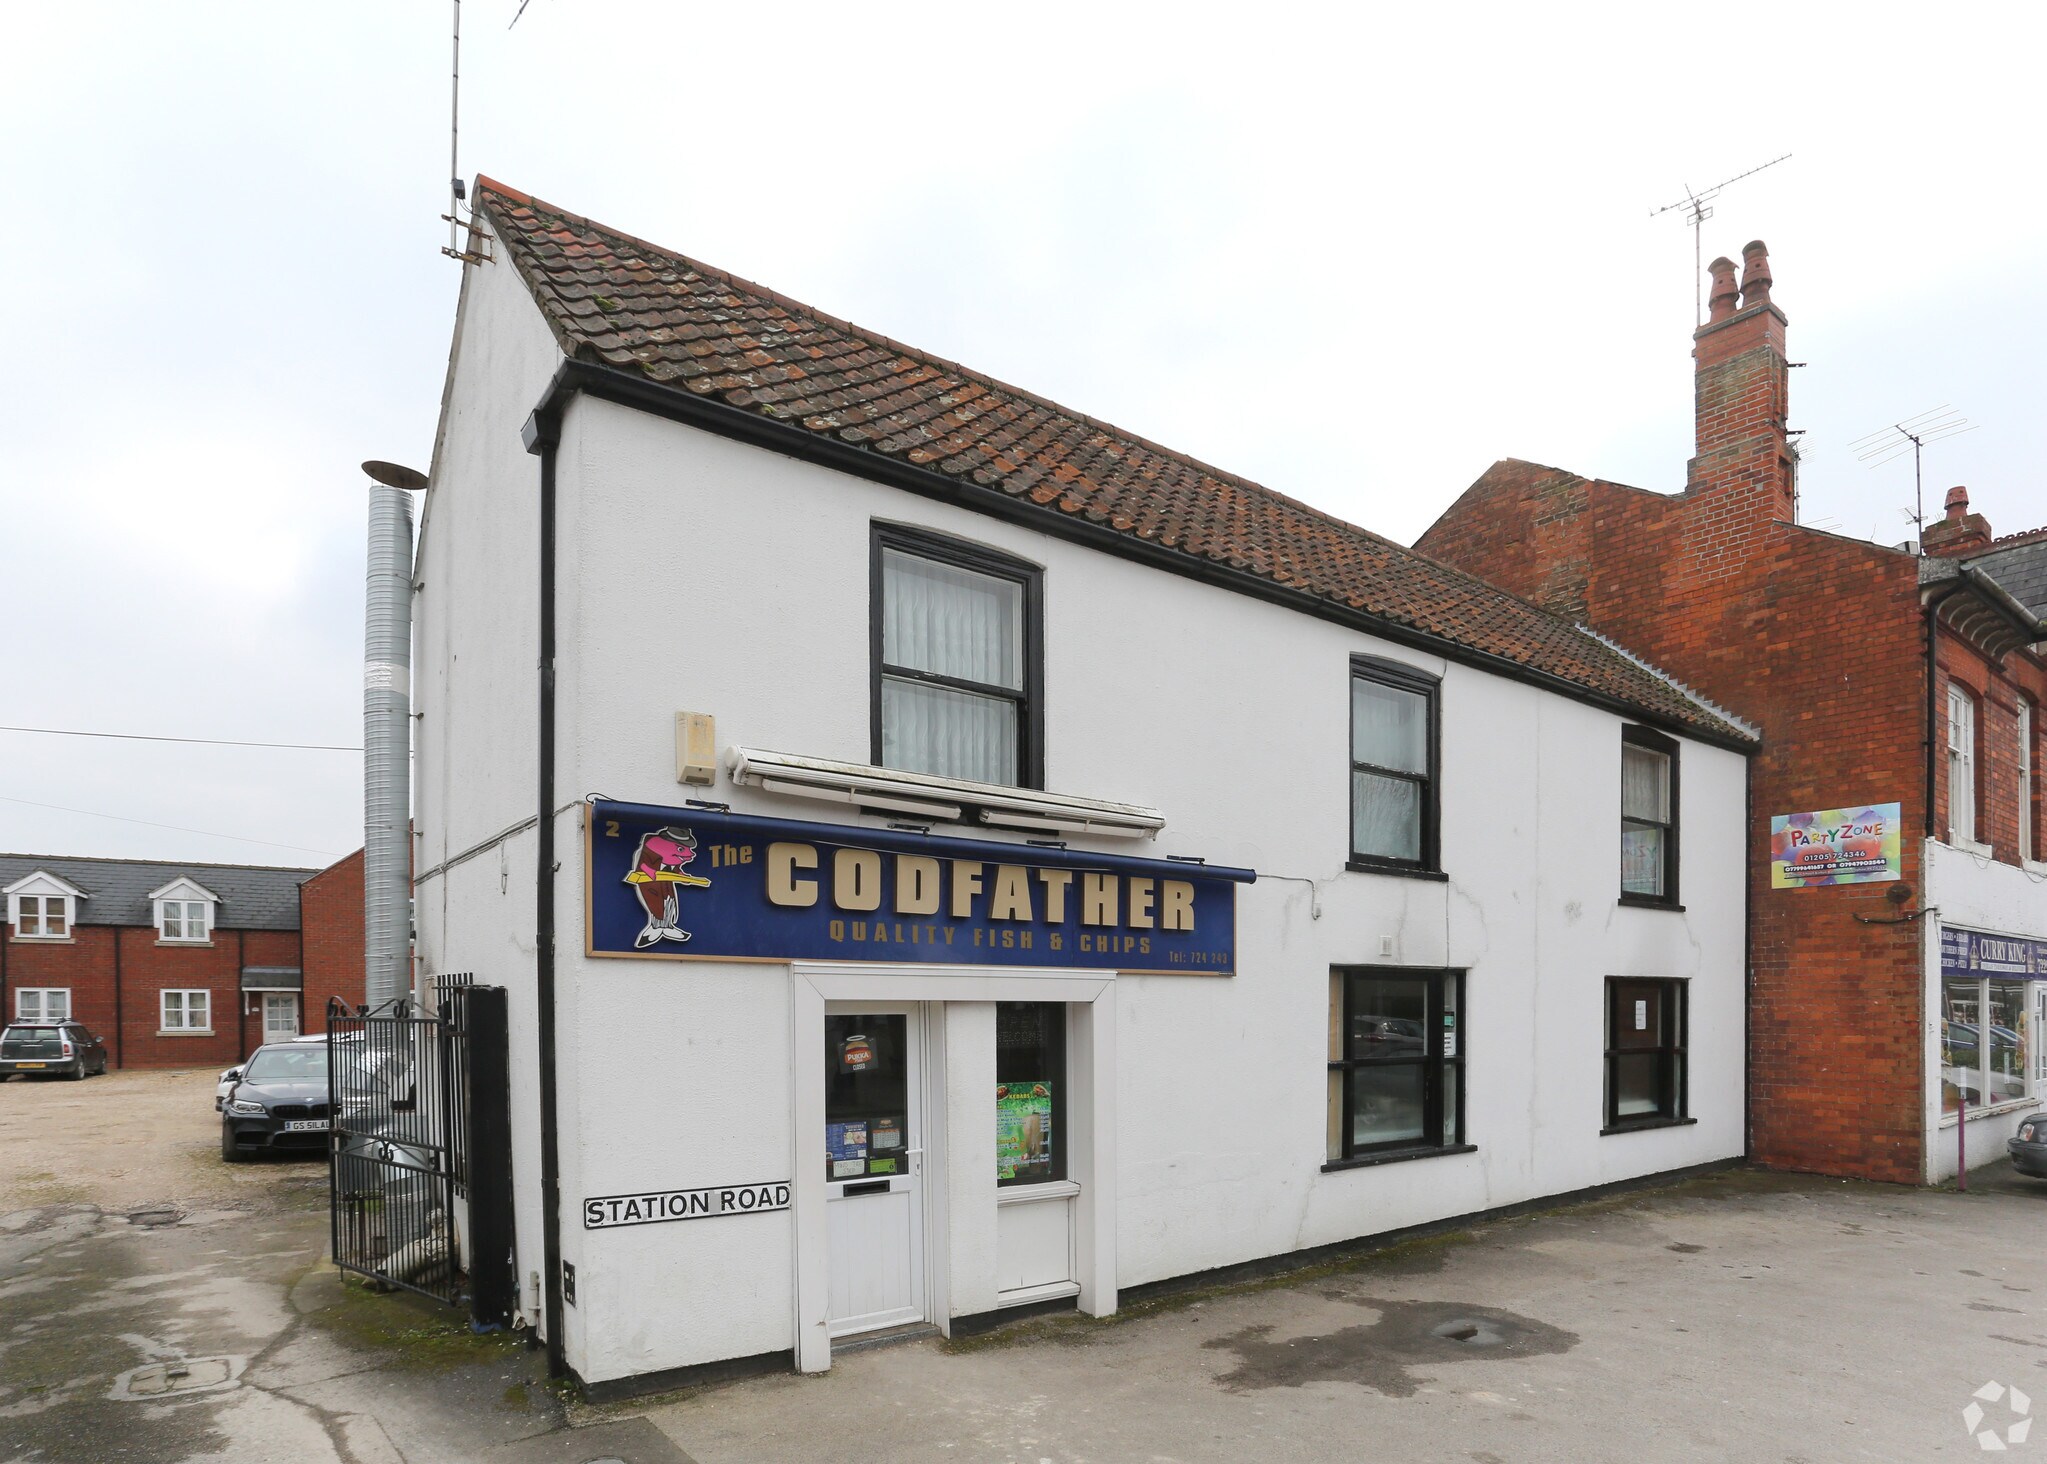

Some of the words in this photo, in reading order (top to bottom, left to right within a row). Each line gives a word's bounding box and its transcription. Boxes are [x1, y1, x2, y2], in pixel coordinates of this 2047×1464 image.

[606, 821, 620, 837] 2
[709, 843, 753, 868] The
[766, 842, 1195, 930] CODFATHER
[829, 919, 956, 945] QUALITY
[974, 928, 1033, 949] FISH
[1050, 932, 1063, 950] &
[1080, 934, 1151, 954] CHIPS
[1169, 951, 1186, 963] Tel:
[1191, 951, 1207, 964] 724
[1980, 939, 2007, 961] CURRY
[2007, 942, 2026, 963] KING
[847, 1051, 869, 1061] PUKKA
[587, 1192, 709, 1224] STATION
[720, 1185, 790, 1211] ROAD
